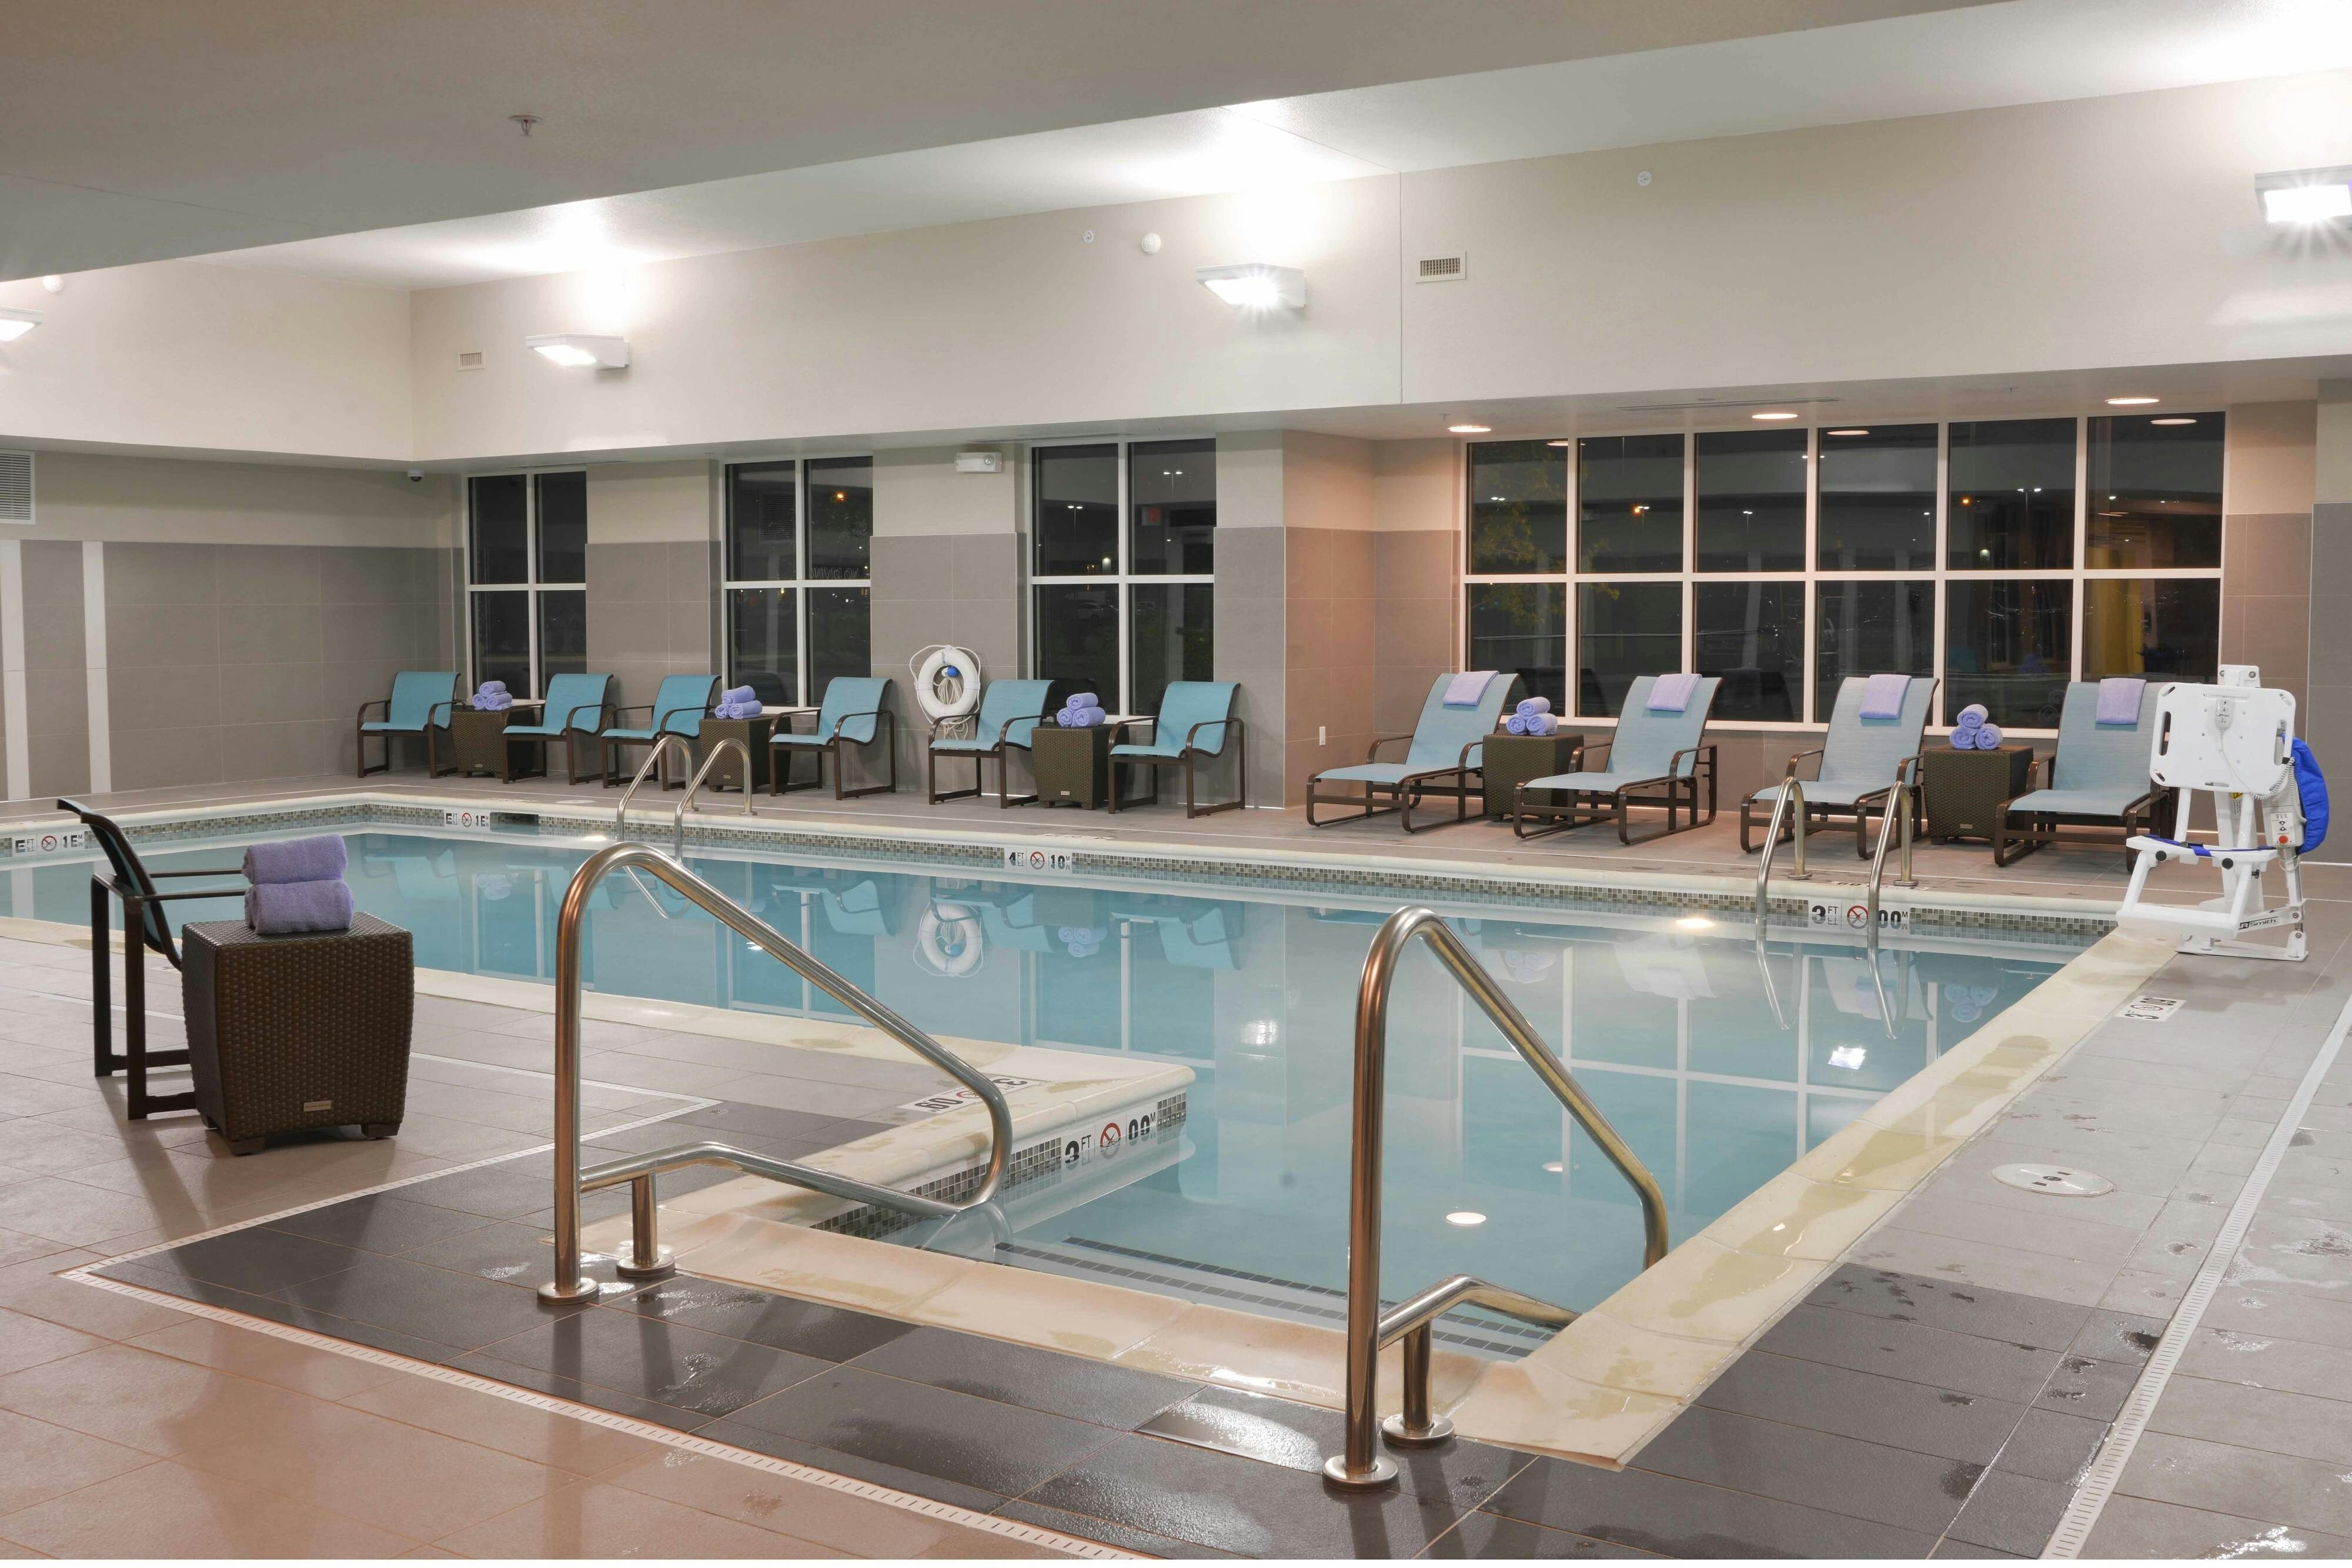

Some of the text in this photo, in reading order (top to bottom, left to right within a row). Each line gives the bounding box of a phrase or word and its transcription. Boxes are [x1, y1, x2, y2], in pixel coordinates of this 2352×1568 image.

[1828, 906, 1839, 915] FT
[2250, 918, 2276, 927] Smith
[991, 1078, 1028, 1086] 3
[1065, 1140, 1080, 1165] 3
[1081, 1134, 1092, 1151] FT
[1150, 1112, 1157, 1123] M
